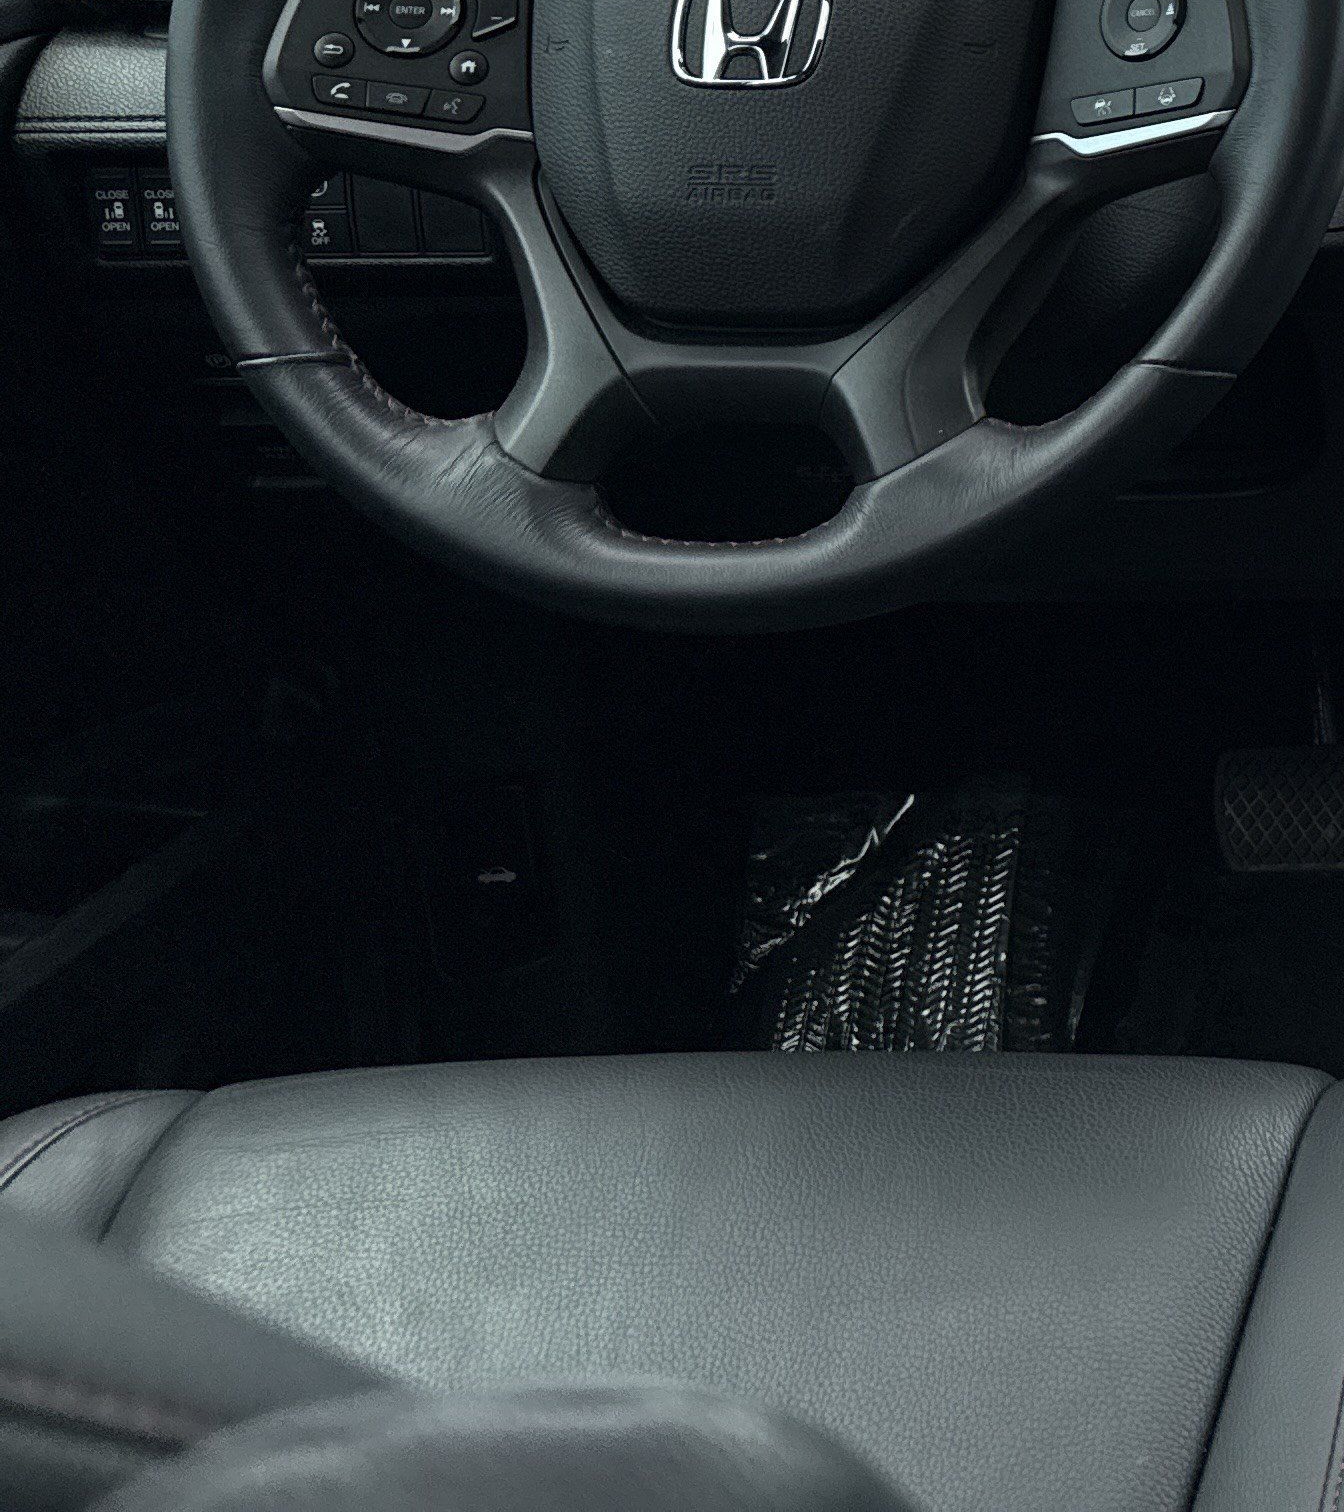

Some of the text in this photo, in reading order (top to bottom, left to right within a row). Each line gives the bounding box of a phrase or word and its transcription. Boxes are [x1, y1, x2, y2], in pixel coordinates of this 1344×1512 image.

[395, 5, 426, 15] ENTER
[686, 164, 778, 182] SRS
[95, 189, 129, 200] CLOSE
[144, 189, 175, 200] CLOS
[102, 221, 131, 232] OPEN
[150, 221, 180, 232] OPEN
[311, 236, 330, 246] OFF
